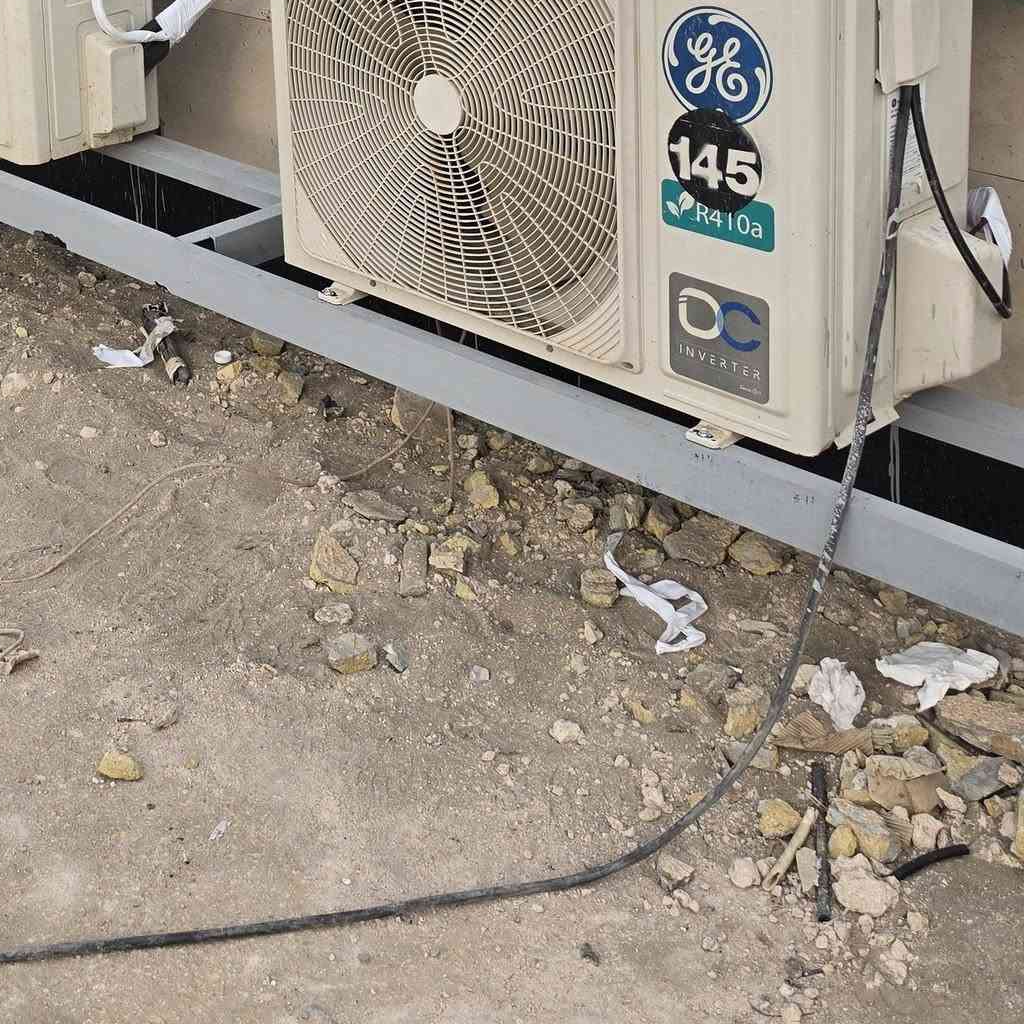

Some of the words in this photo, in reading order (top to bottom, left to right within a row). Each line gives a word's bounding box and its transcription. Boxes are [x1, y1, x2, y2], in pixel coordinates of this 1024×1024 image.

[685, 32, 748, 102] GE
[669, 135, 760, 197] 145
[695, 201, 763, 240] R410a
[678, 286, 761, 352] DC
[679, 343, 760, 380] INVERTER
